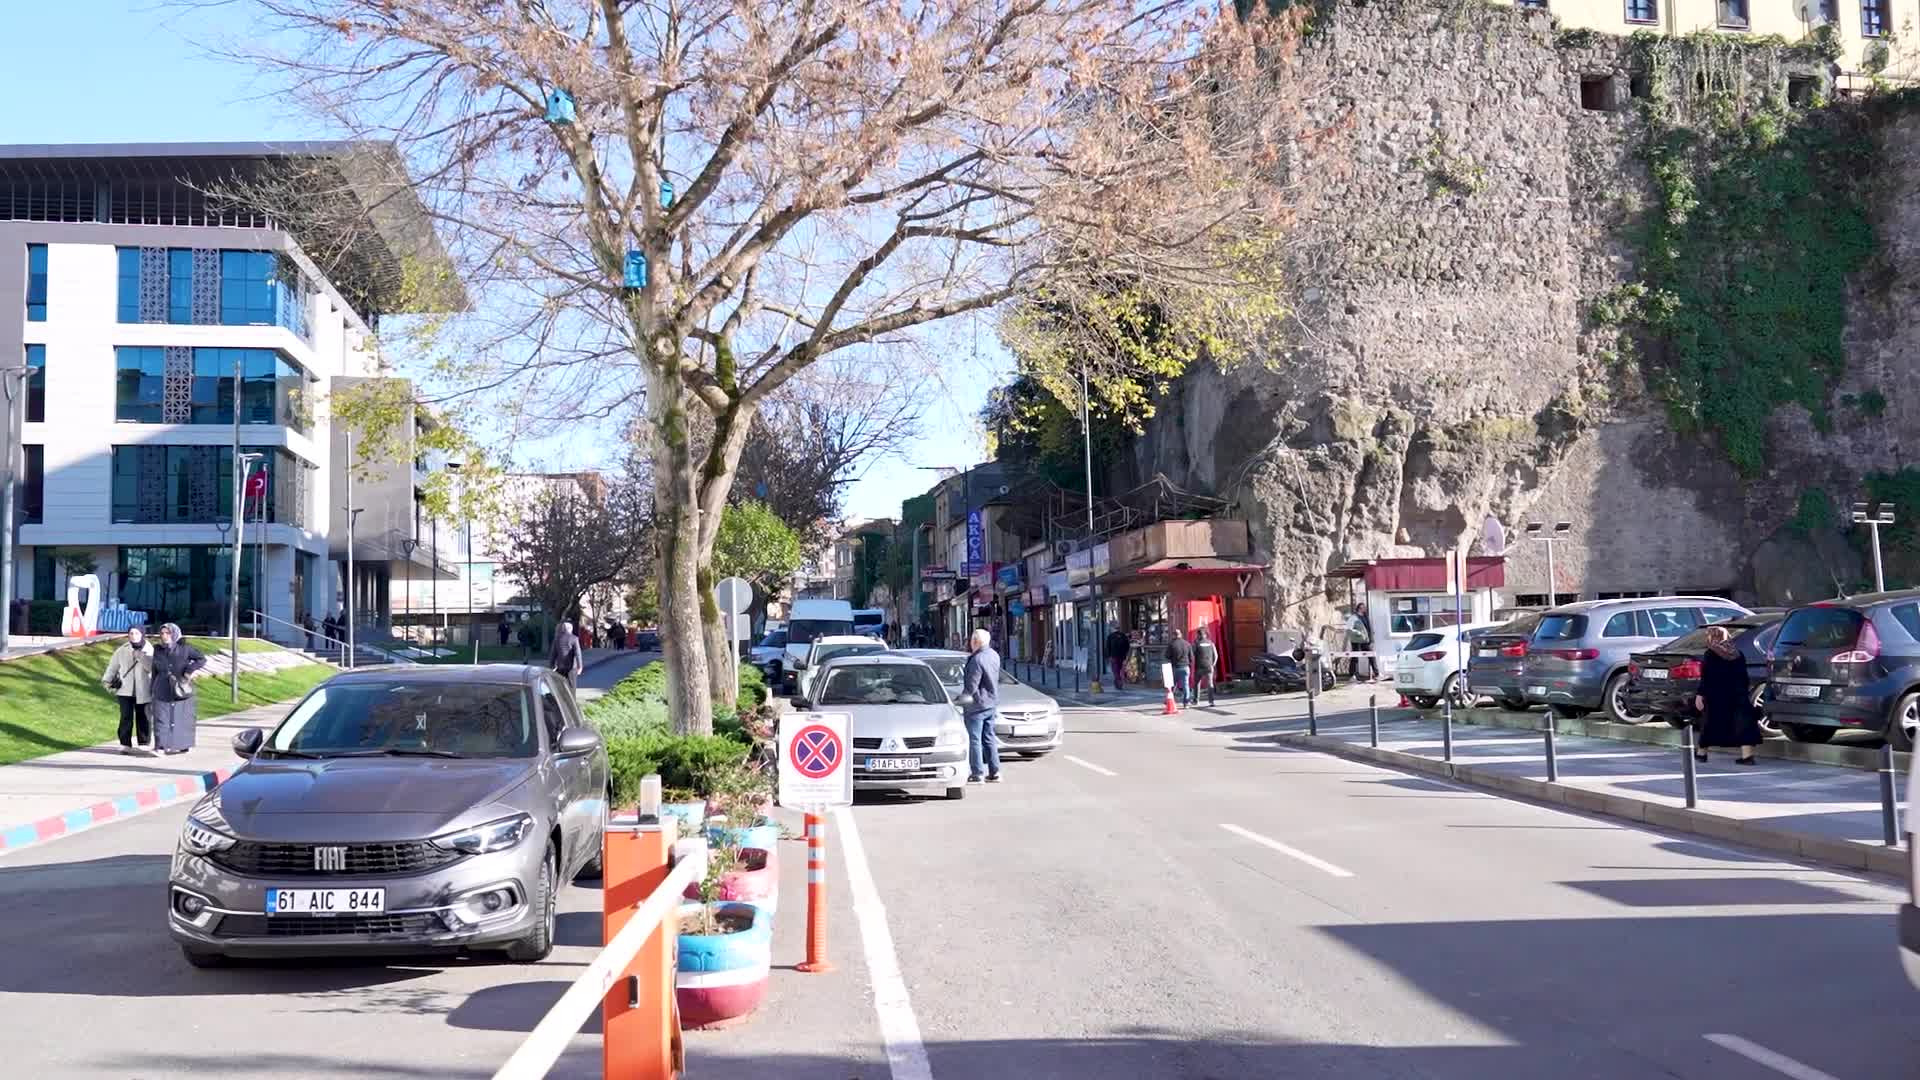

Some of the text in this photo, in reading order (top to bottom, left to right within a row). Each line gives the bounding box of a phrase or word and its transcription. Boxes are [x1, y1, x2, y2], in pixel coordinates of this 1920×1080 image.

[314, 847, 348, 870] FIAT
[278, 891, 380, 909] 61 AIC 844
